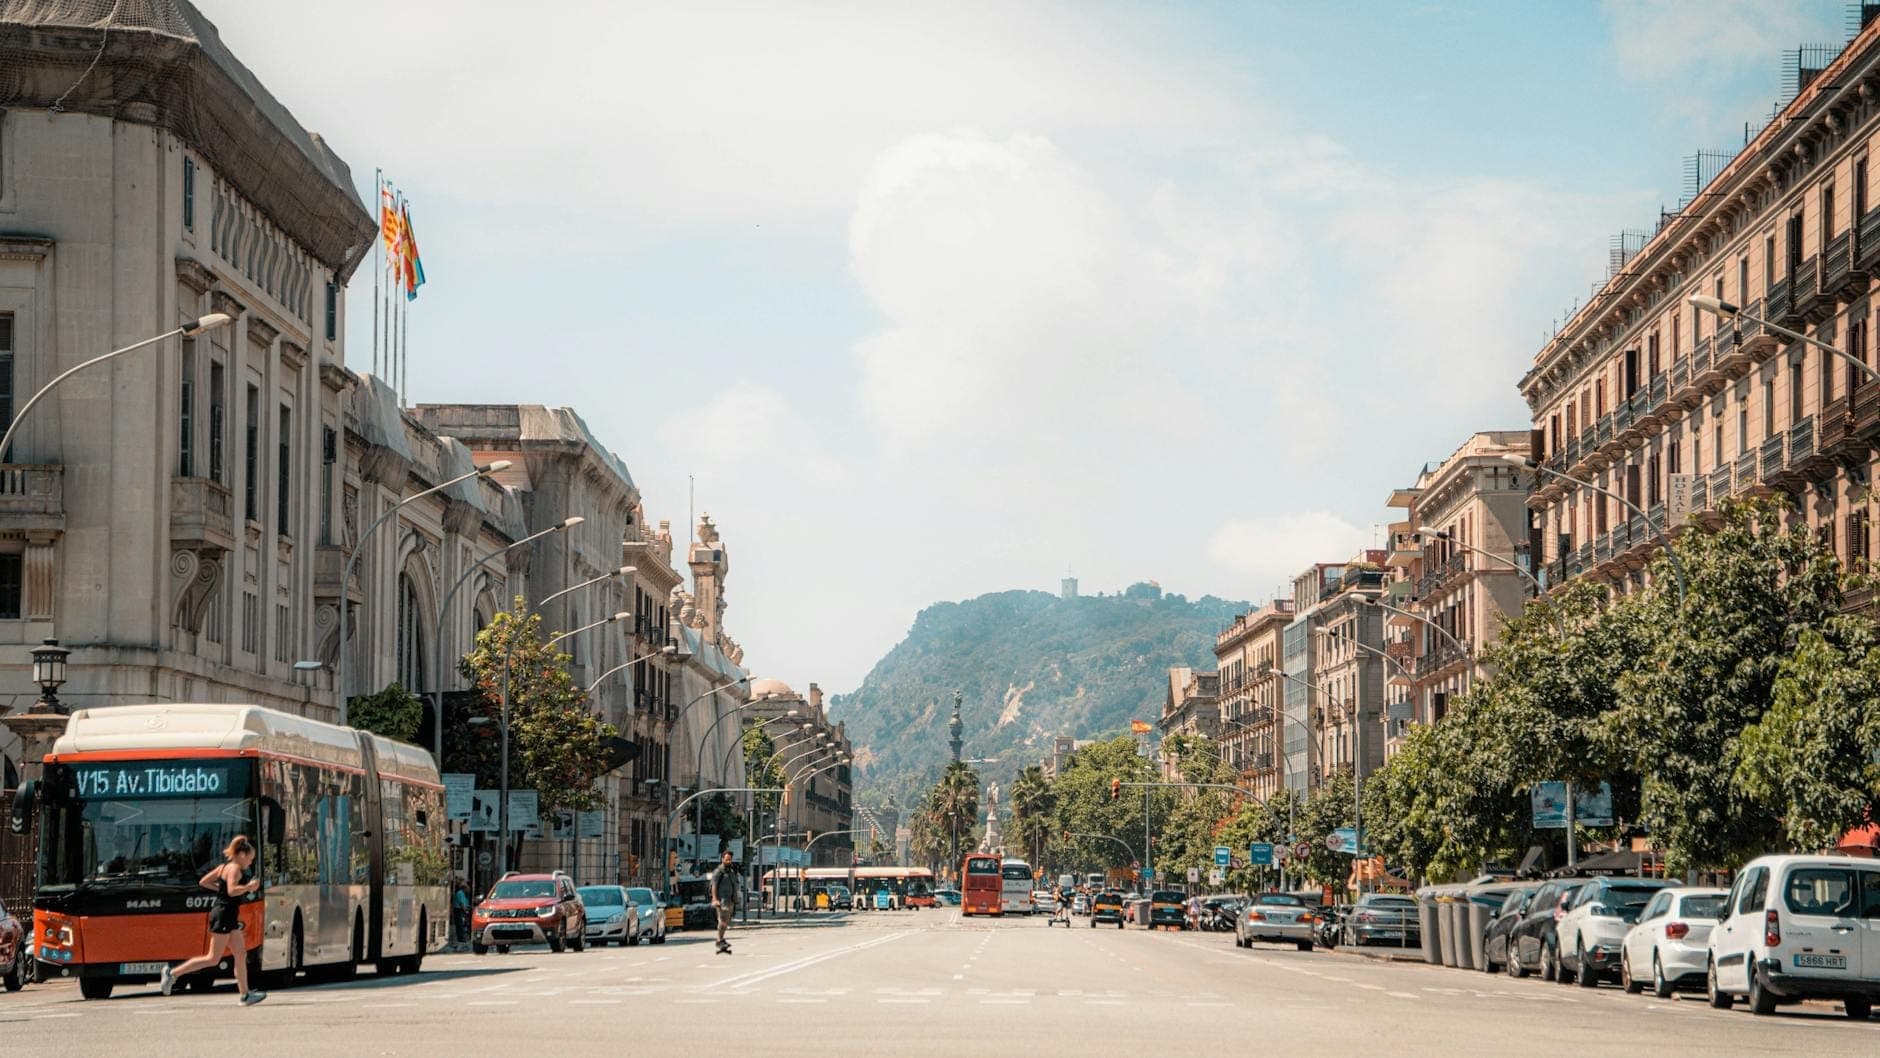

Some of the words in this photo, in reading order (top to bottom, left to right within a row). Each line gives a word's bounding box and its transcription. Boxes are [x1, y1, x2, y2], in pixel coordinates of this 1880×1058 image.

[1674, 477, 1686, 513] HOSTAL
[76, 770, 109, 795] V15
[126, 900, 161, 908] MAN
[186, 897, 217, 908] 6077
[1800, 957, 1824, 966] 5866
[1826, 958, 1844, 966] HRT
